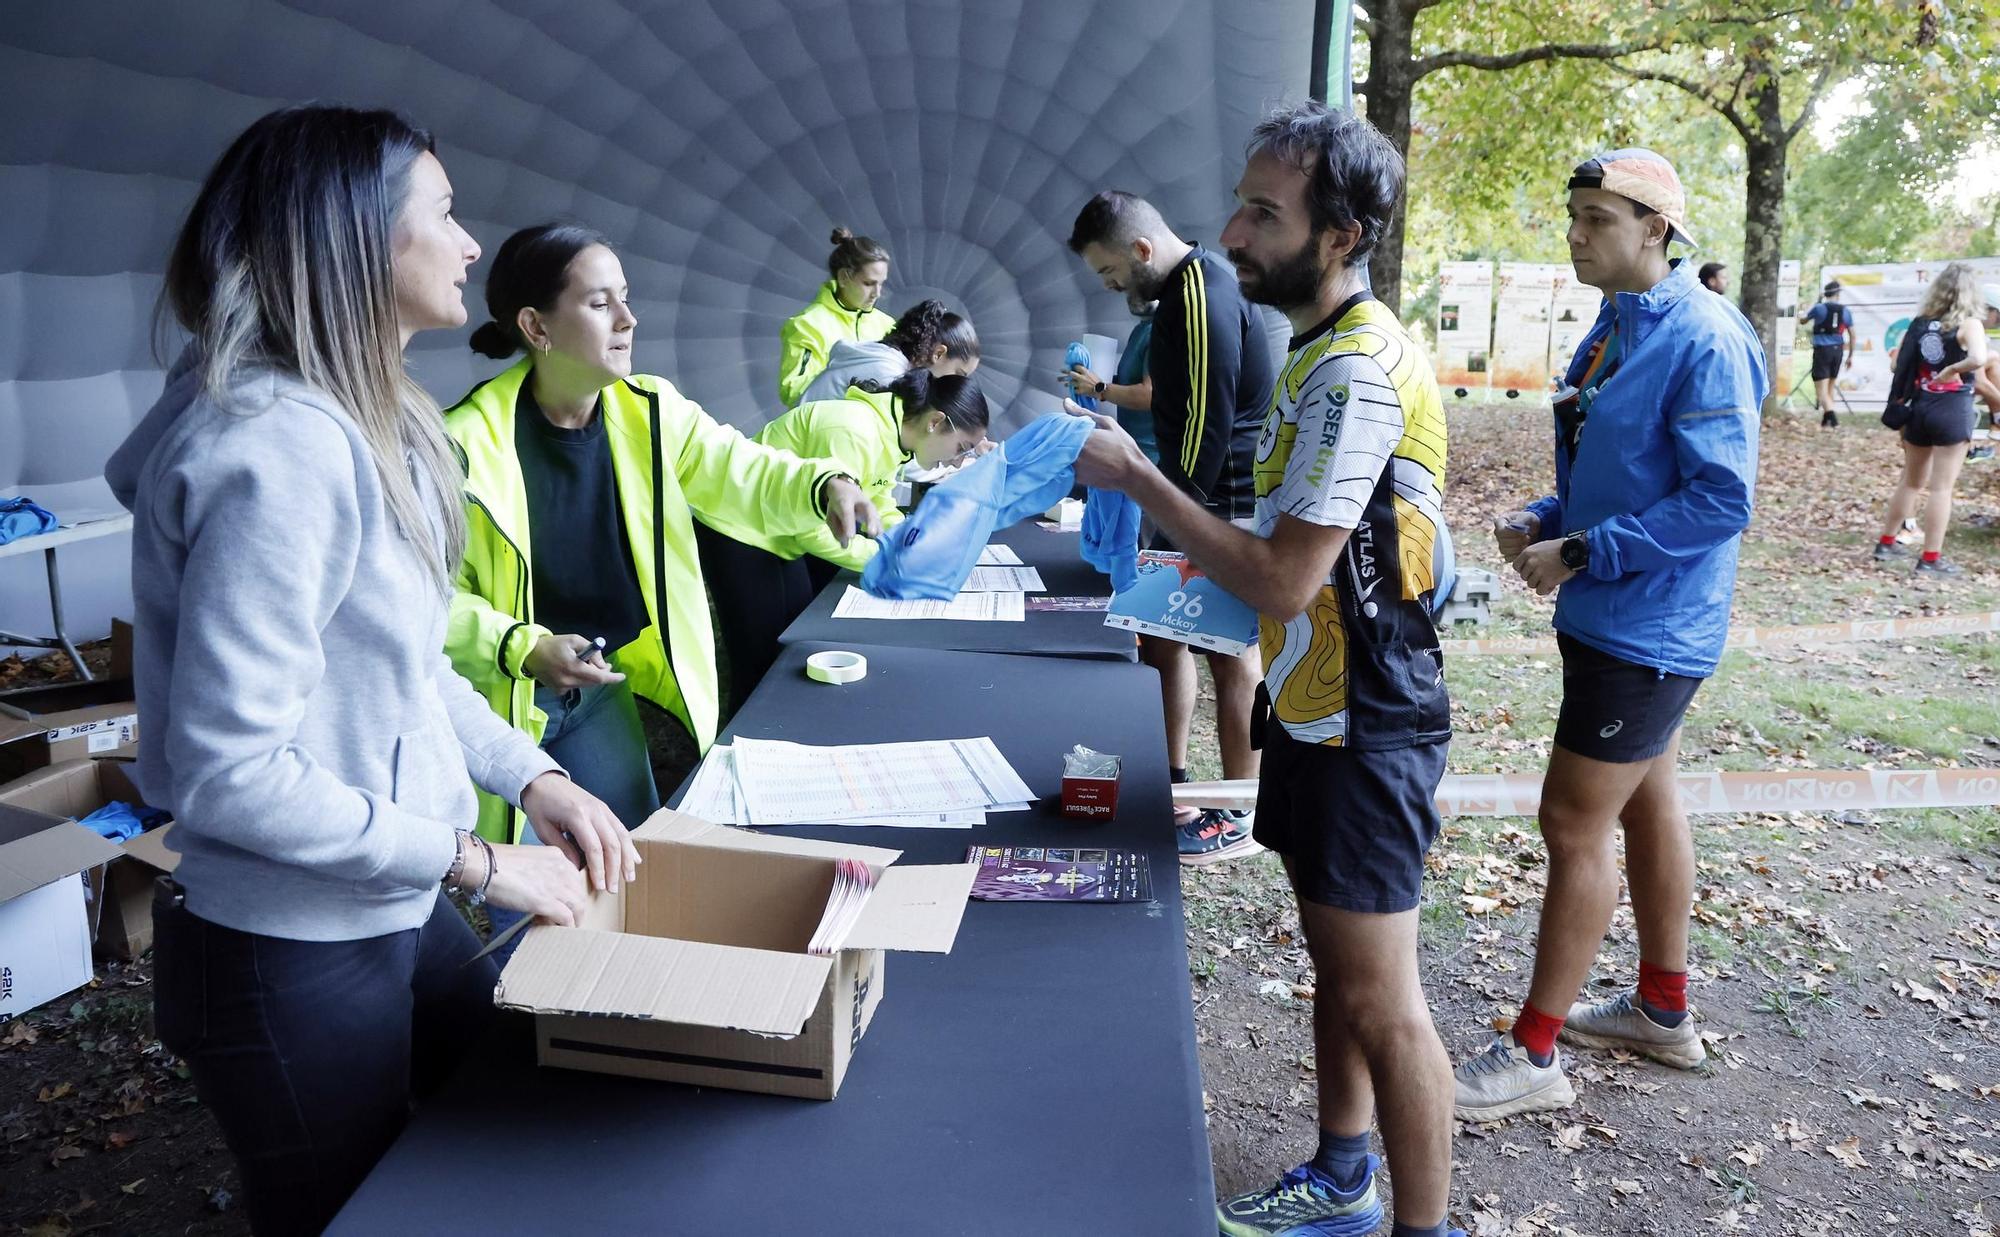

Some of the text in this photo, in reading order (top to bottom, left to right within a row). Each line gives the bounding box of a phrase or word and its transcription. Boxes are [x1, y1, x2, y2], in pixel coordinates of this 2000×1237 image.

[1358, 520, 1376, 578] ATLAS
[1167, 590, 1203, 618] 96
[2, 967, 13, 1000] 42K
